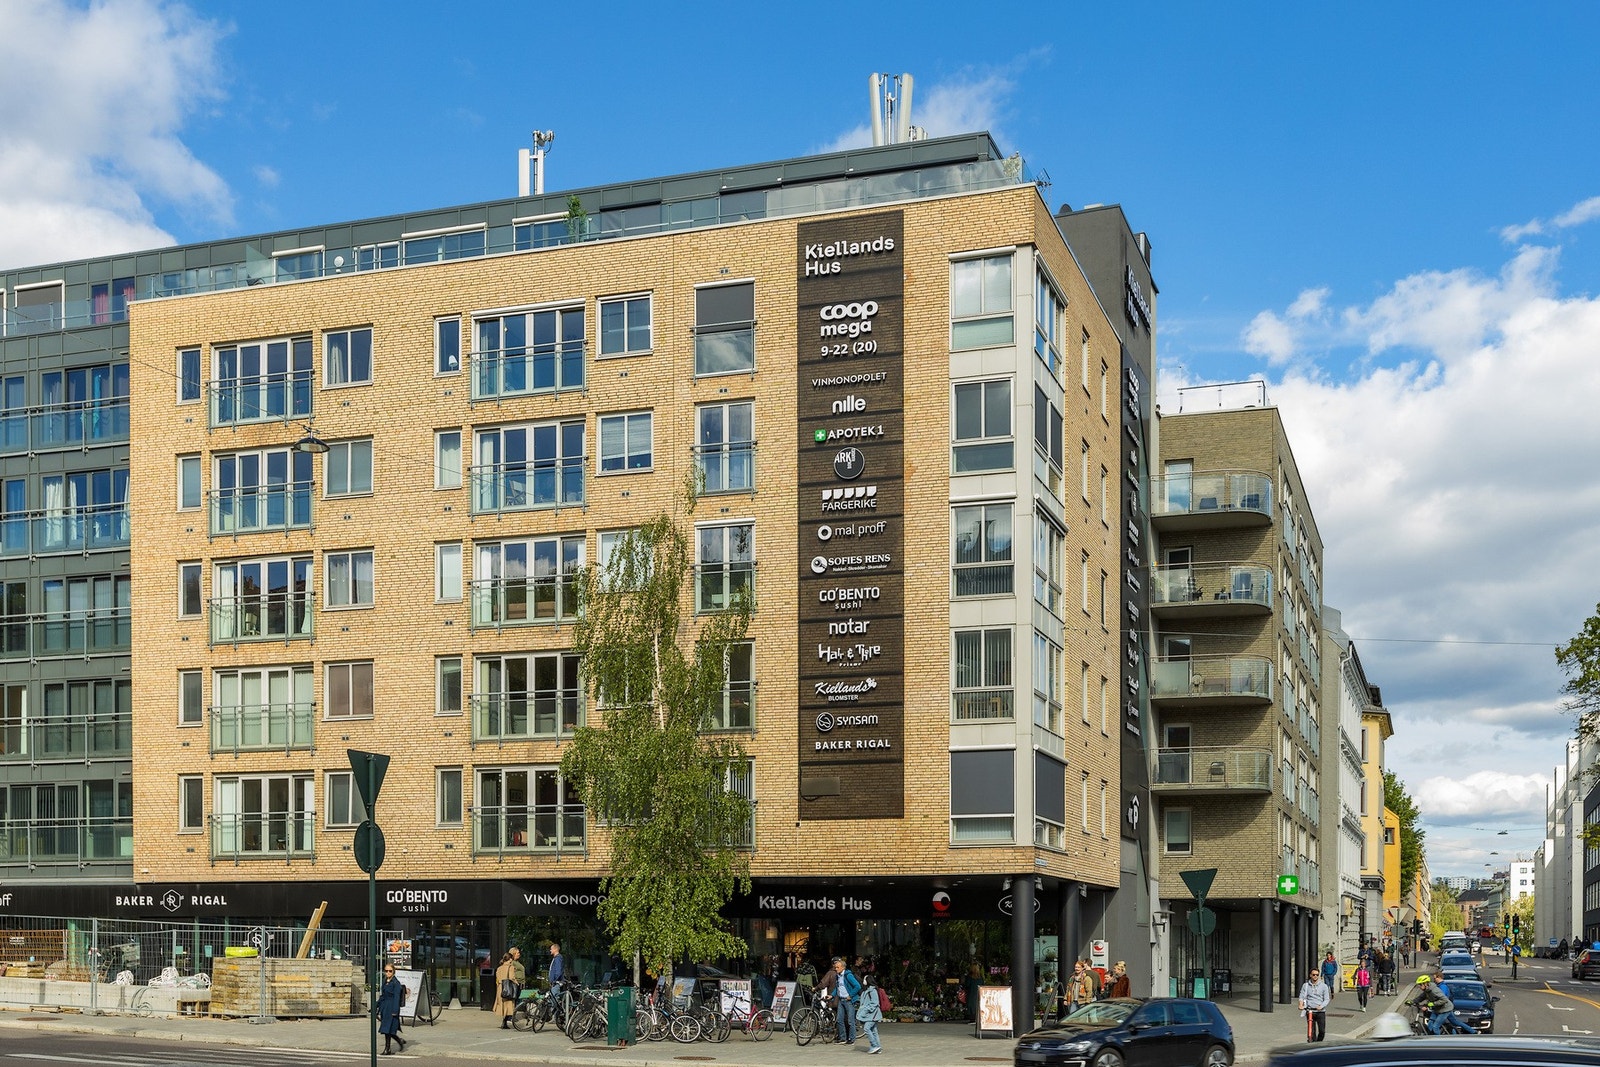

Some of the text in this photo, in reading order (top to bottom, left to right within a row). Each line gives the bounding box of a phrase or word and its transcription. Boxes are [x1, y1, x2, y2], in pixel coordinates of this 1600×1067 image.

[805, 236, 895, 260] Kiellands
[805, 260, 841, 276] Hus
[820, 301, 879, 320] coop
[820, 320, 872, 338] mega
[821, 340, 877, 357] 9-22 (20)
[812, 372, 887, 387] VINMONOPOLET
[832, 395, 866, 413] nille
[834, 451, 851, 463] ARK
[822, 499, 877, 512] FARGERIKE
[835, 521, 887, 537] mal proff
[828, 553, 891, 566] SOFIES RENS
[835, 600, 862, 609] sushi
[829, 618, 870, 635] notar
[818, 643, 844, 662] Hair
[847, 647, 854, 660] &
[815, 680, 870, 694] Kiellands
[828, 694, 859, 702] BLOMSTER
[815, 739, 891, 750] BAKER RIGAL
[115, 896, 153, 906] BAKER
[191, 895, 227, 906] RIGAL
[523, 894, 608, 905] VINMONOPO
[759, 895, 872, 910] Kiellands Hus
[402, 903, 429, 912] sushi
